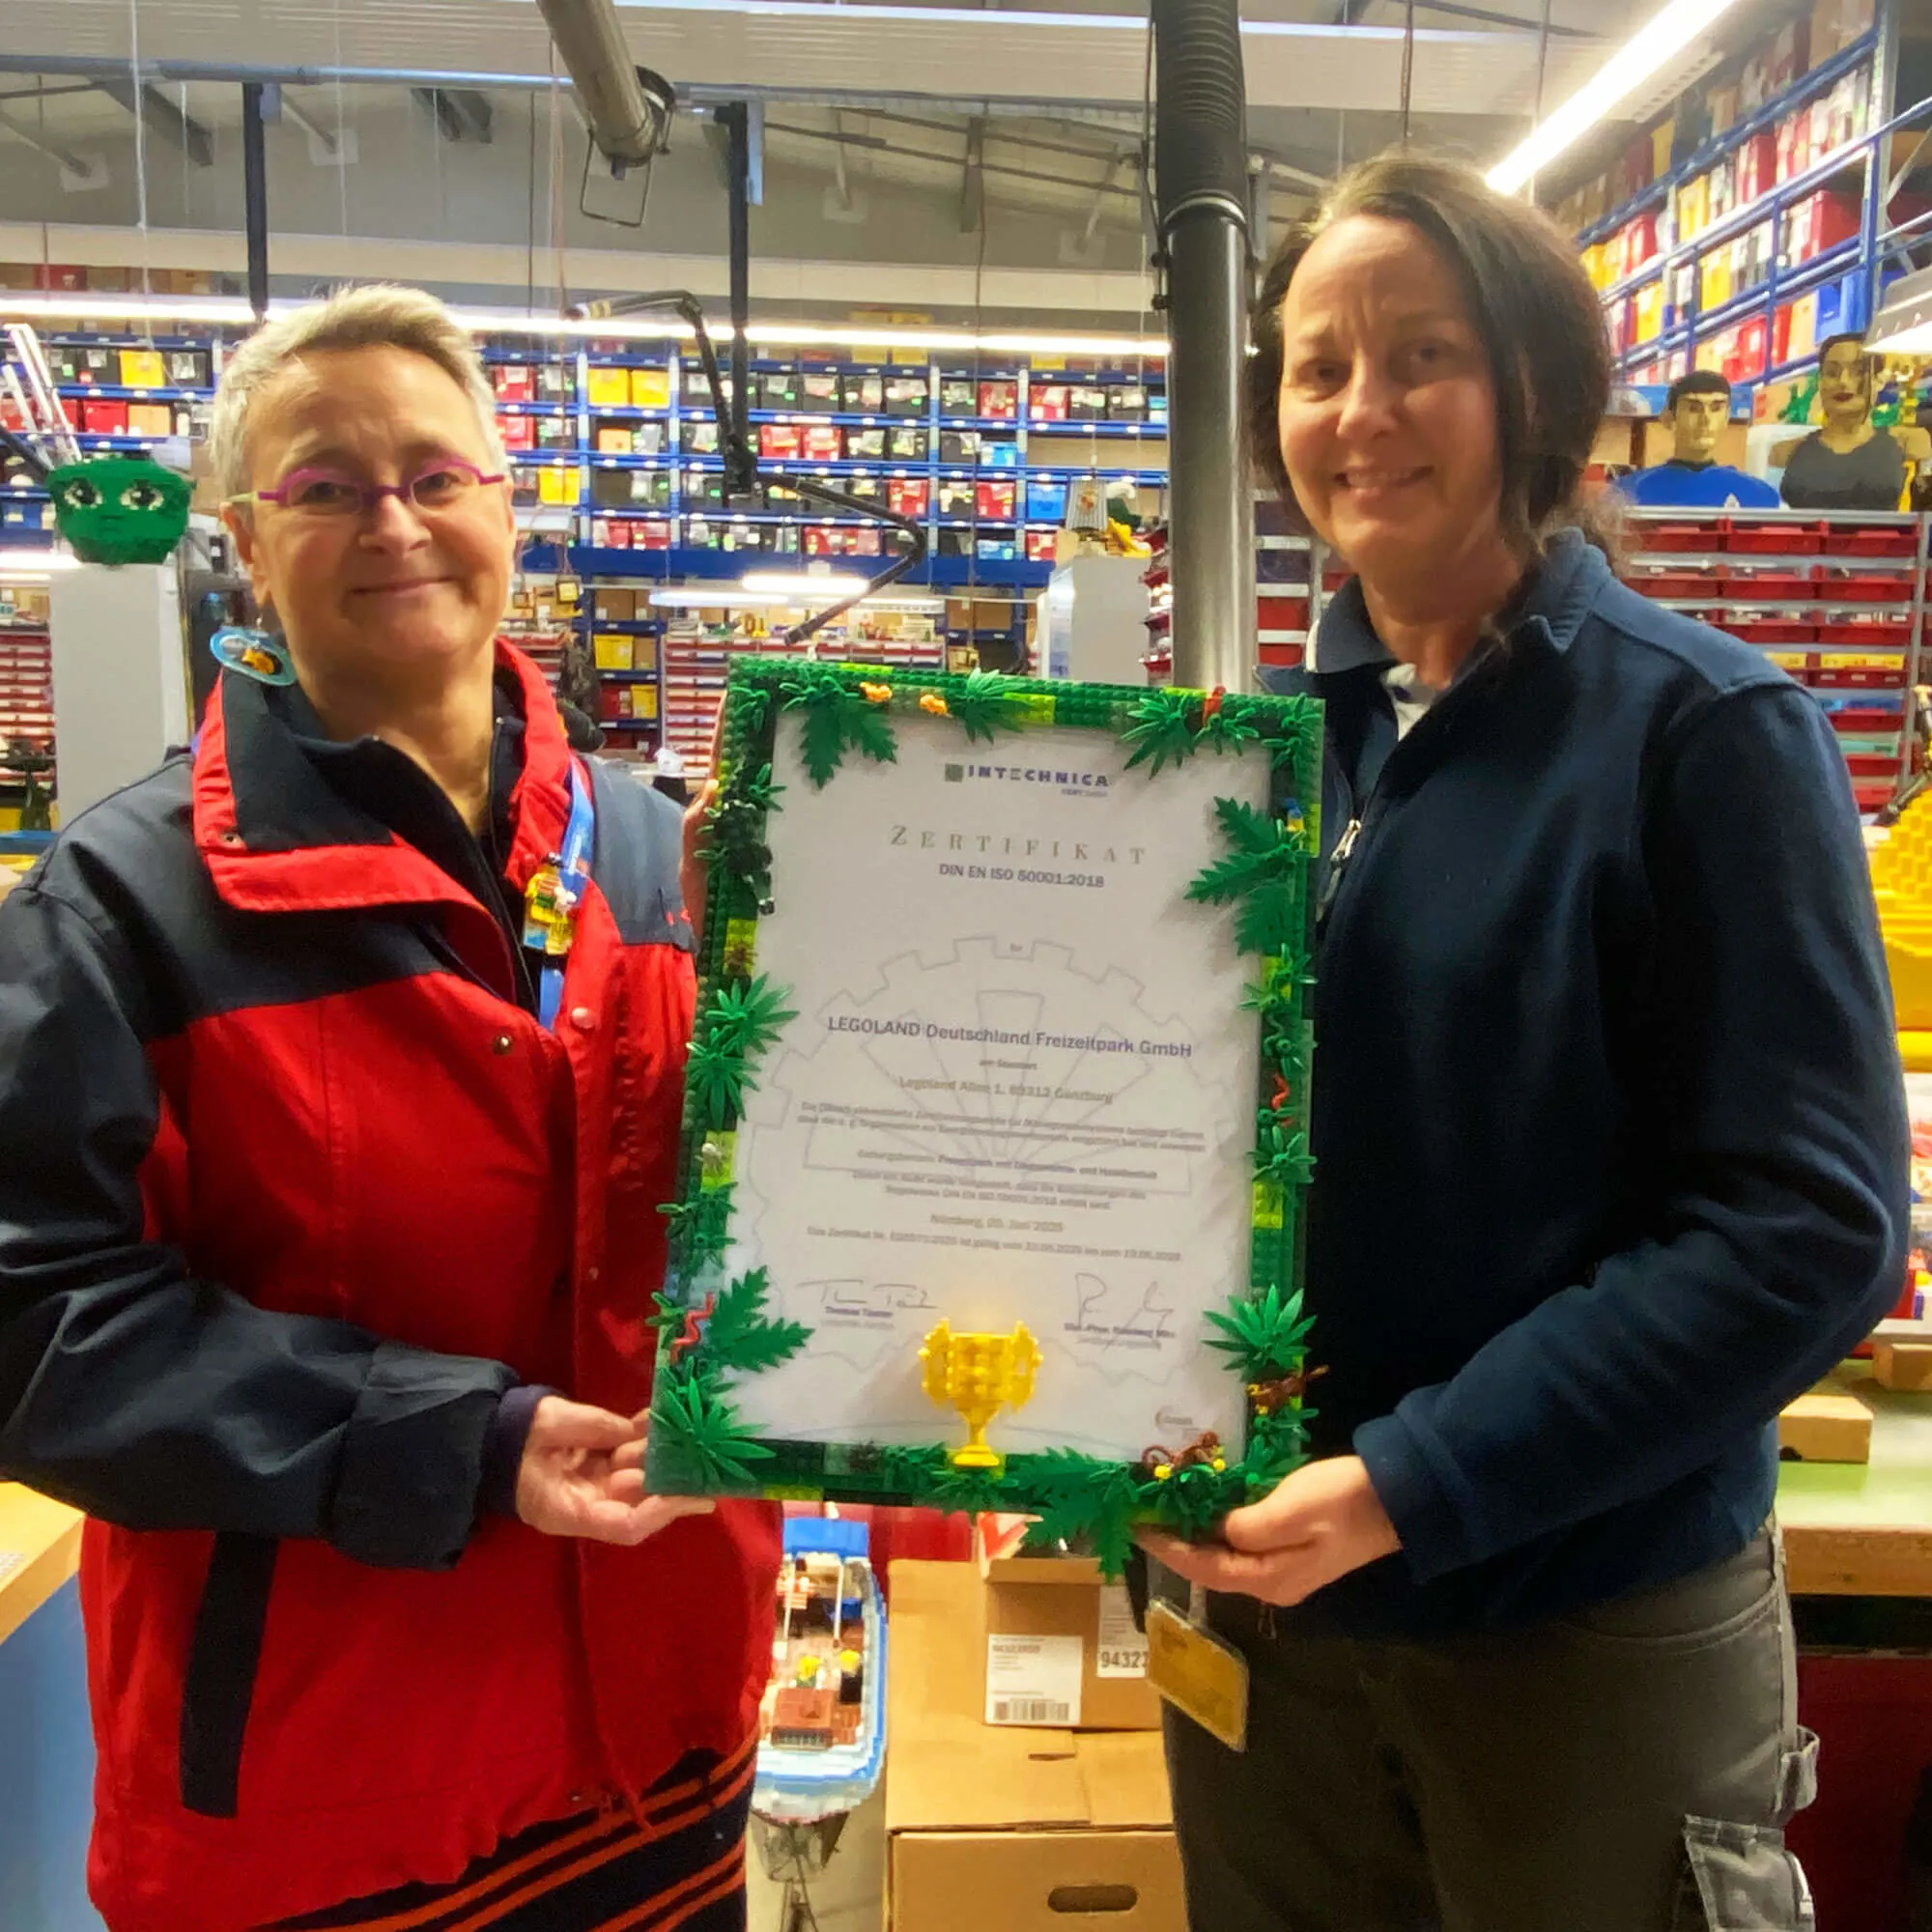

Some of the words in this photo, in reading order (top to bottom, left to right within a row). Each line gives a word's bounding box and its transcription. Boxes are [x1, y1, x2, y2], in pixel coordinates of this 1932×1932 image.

[968, 764, 1109, 787] INTECHNICA
[890, 825, 1146, 866] ZERTIFIKAT
[939, 863, 964, 877] DIN
[968, 865, 987, 879] EN
[990, 867, 1014, 881] ISO
[827, 1016, 921, 1037] LEGOLAND
[925, 1023, 1031, 1046] Deutschland
[1036, 1031, 1134, 1055] Freizeitpark
[1139, 1039, 1192, 1058] GmbH
